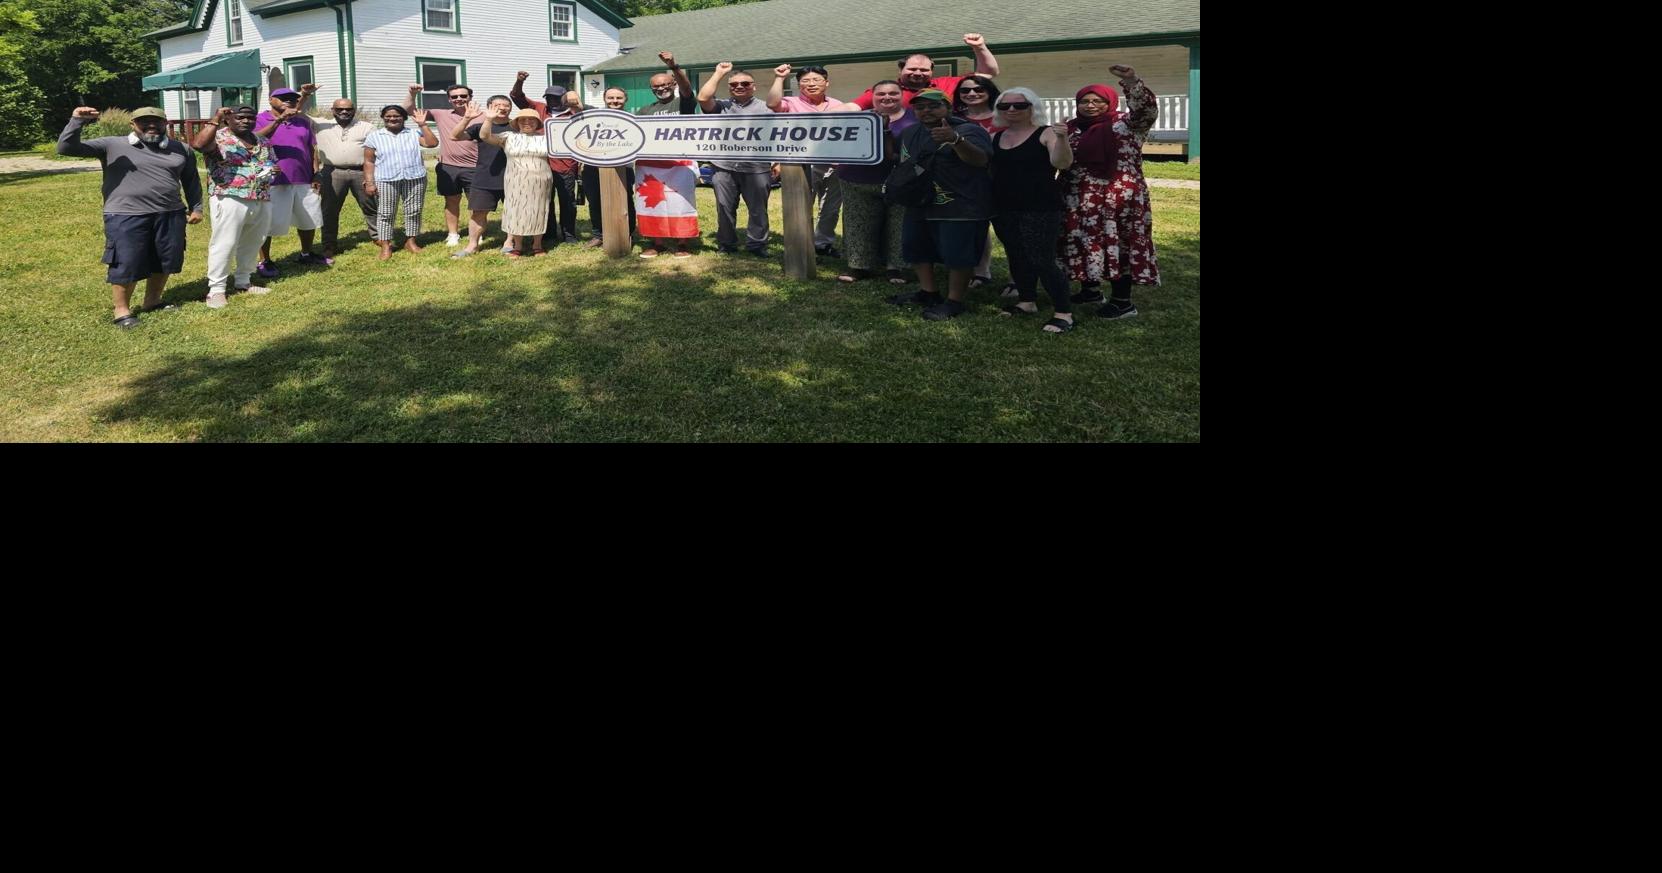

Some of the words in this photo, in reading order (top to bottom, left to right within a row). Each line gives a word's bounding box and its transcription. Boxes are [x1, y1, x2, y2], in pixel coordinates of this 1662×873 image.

[575, 122, 628, 148] Ajax
[654, 127, 763, 141] HARTRICK
[770, 126, 859, 141] HOUSE
[696, 143, 716, 151] 120
[720, 143, 772, 152] Roberson
[776, 144, 807, 152] Drive
